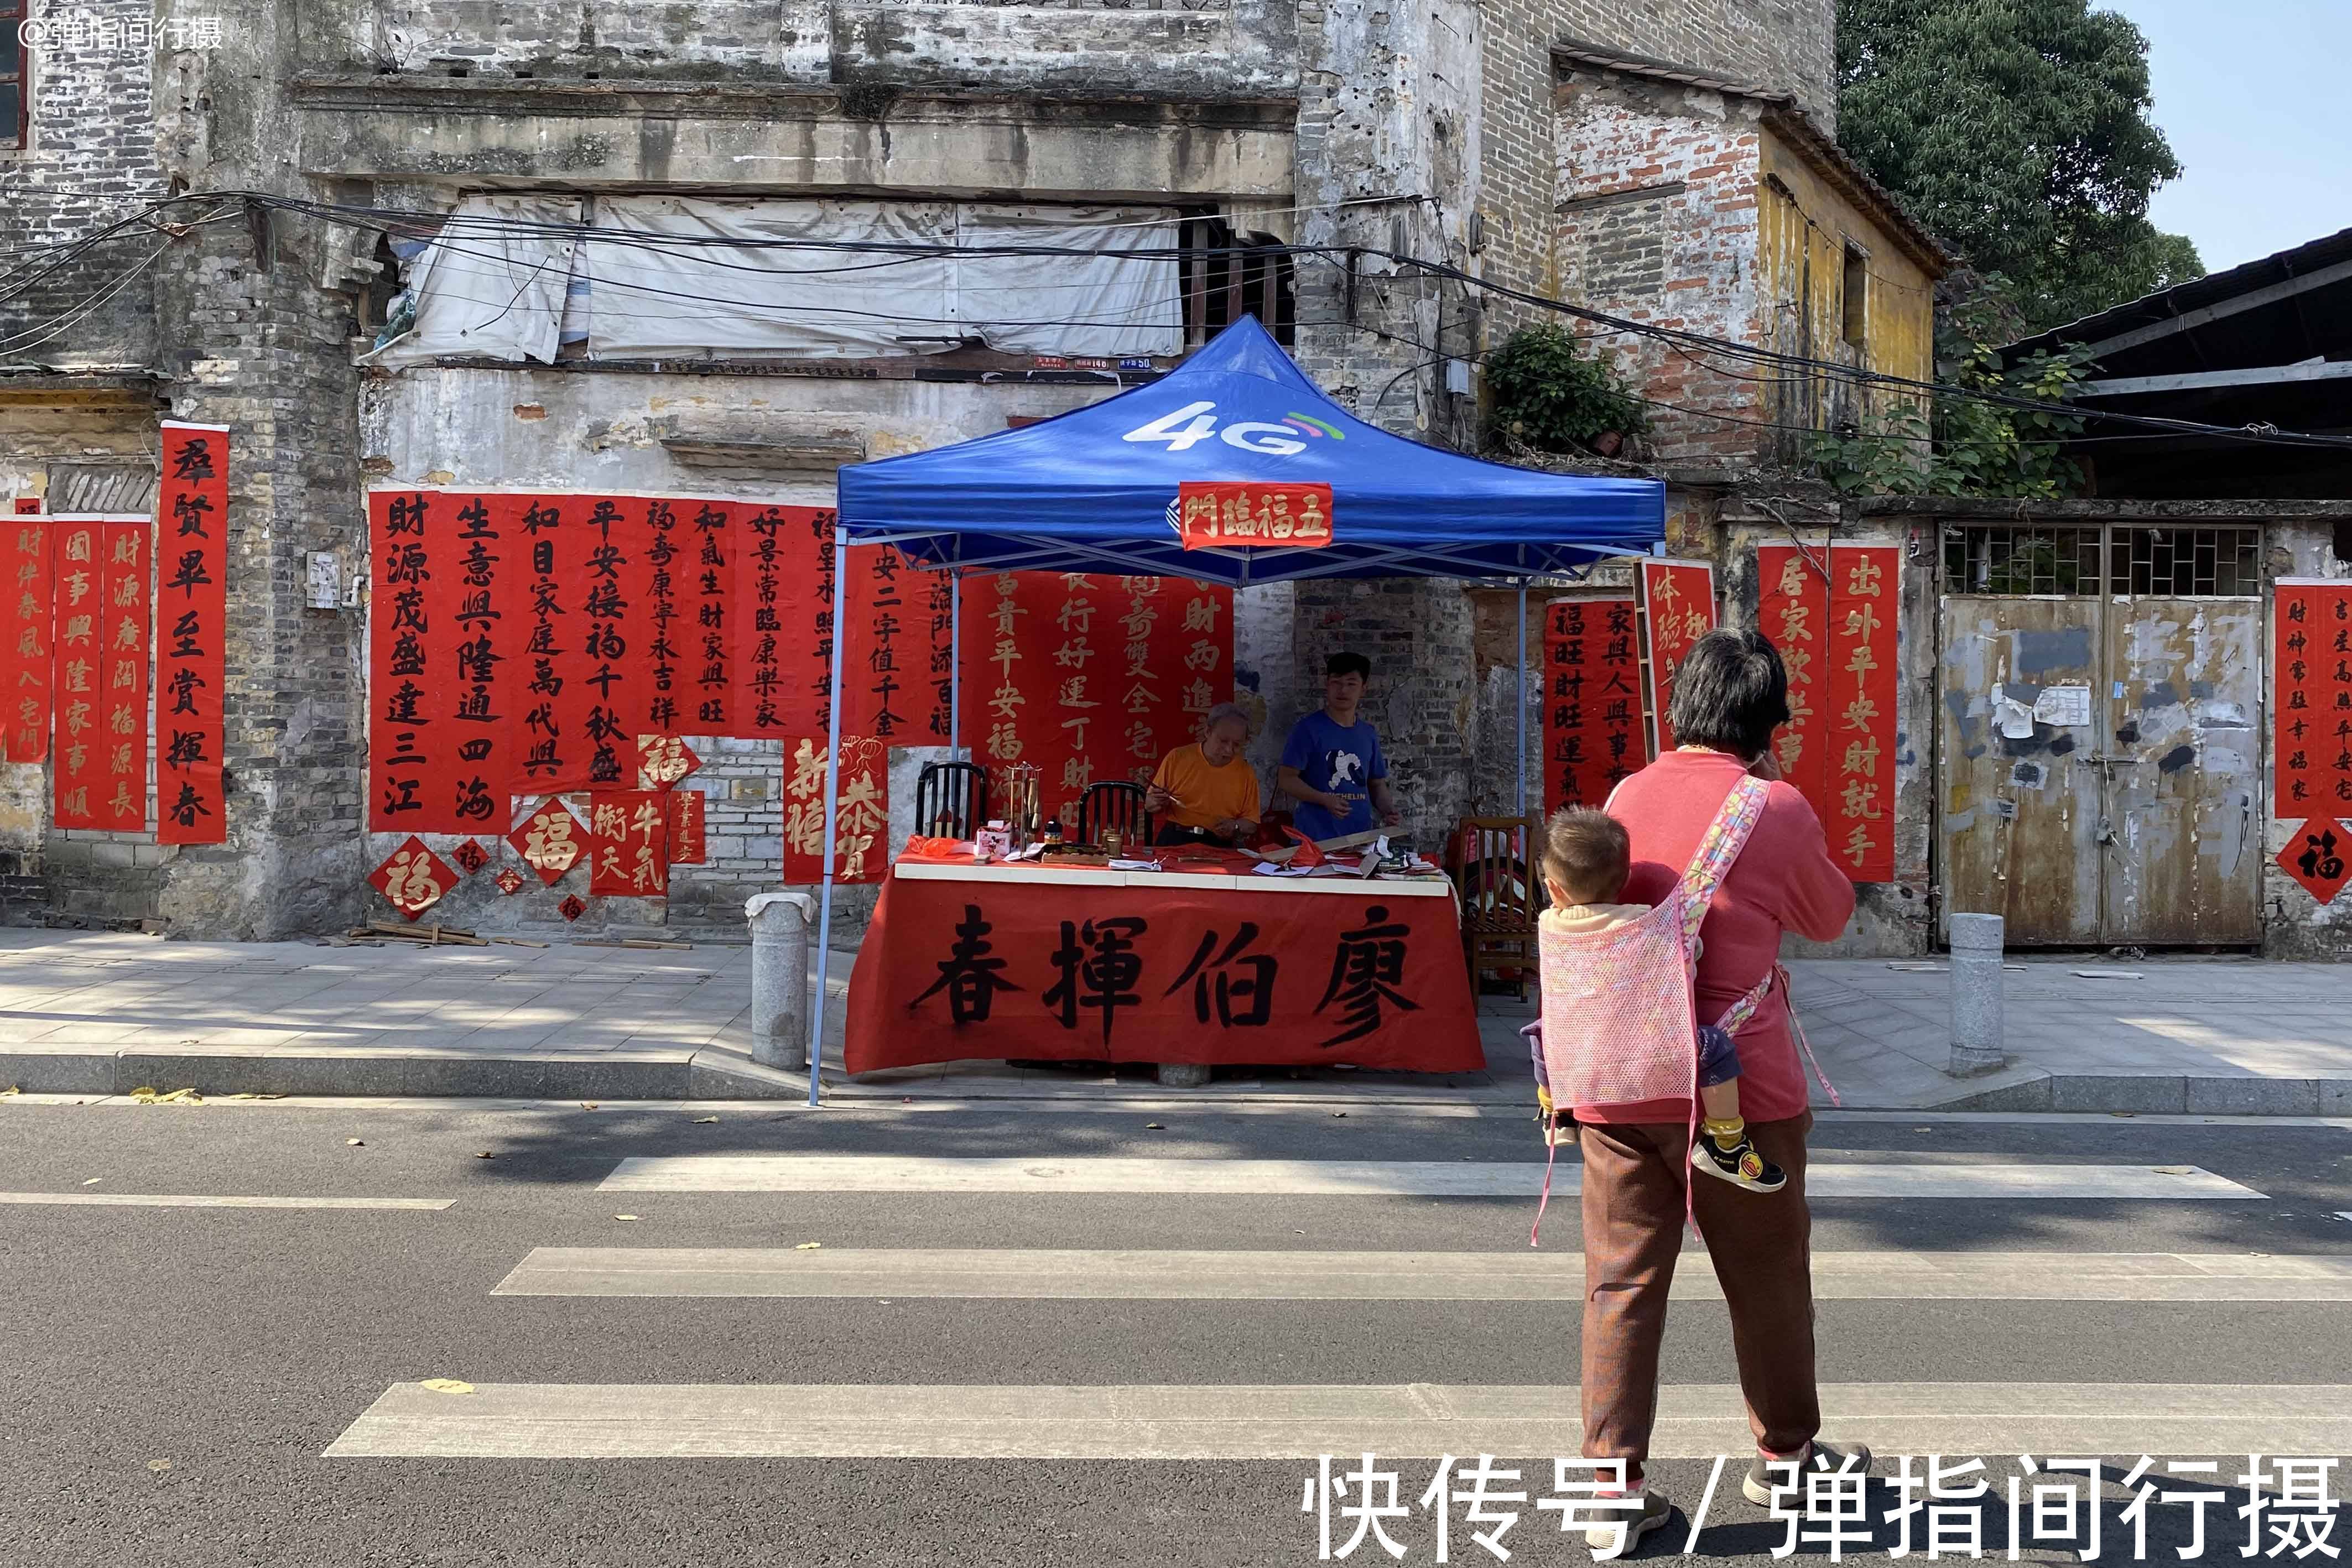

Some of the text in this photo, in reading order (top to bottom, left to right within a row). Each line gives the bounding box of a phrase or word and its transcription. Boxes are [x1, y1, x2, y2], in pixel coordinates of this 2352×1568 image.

[1122, 401, 1307, 455] 4G
[868, 544, 909, 736] 安二字值千金
[1553, 605, 1589, 808] 福旺財旺運氣
[1840, 554, 1882, 868] 出外平安財就手
[644, 734, 688, 782] 福
[524, 811, 578, 870] 福
[2298, 830, 2345, 881] 福
[386, 850, 441, 911] 福
